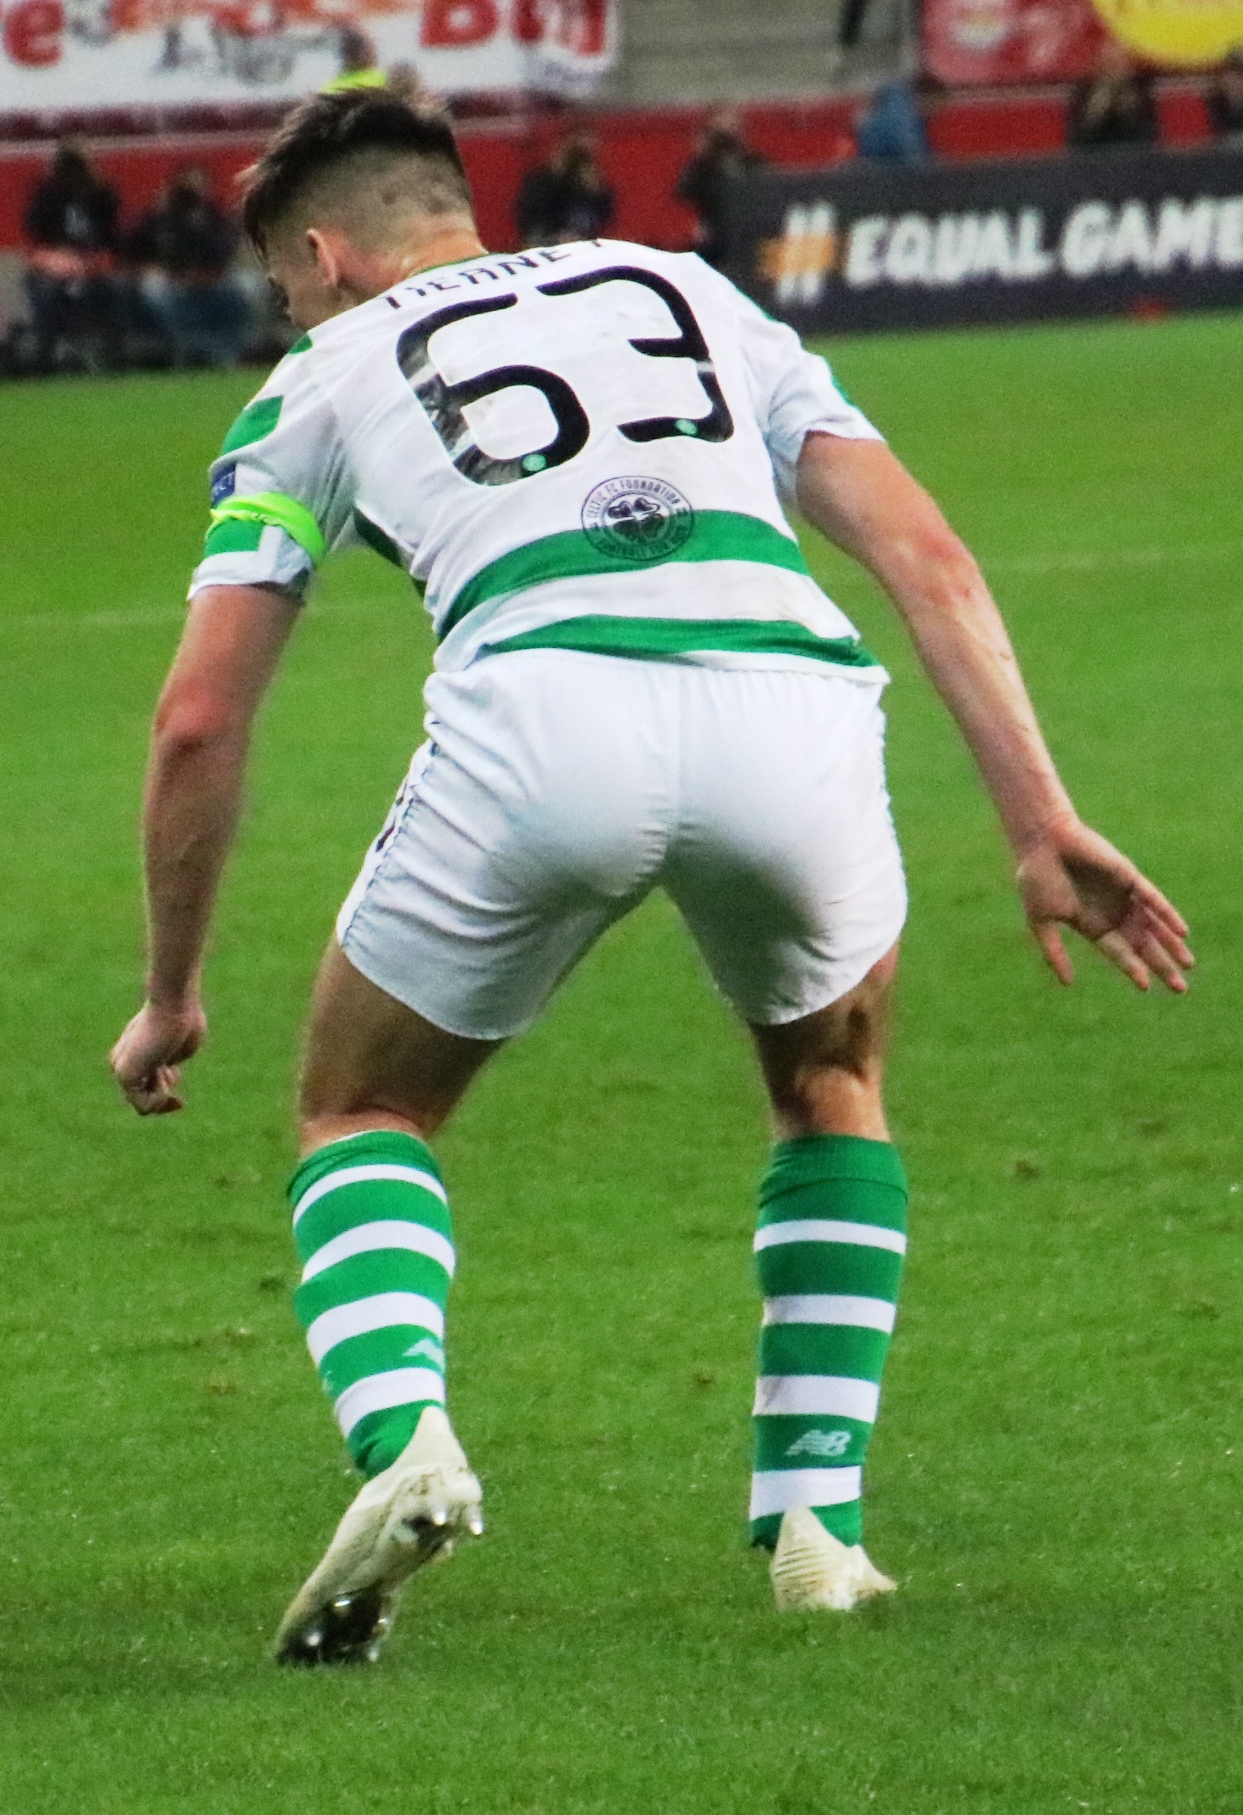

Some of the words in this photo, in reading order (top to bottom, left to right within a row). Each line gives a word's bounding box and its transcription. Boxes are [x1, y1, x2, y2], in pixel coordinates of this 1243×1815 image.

[380, 238, 602, 310] TIERNE
[396, 264, 735, 487] 63
[586, 490, 608, 519] CELTIC
[605, 482, 619, 493] FC
[619, 479, 681, 505] FOUNDATION
